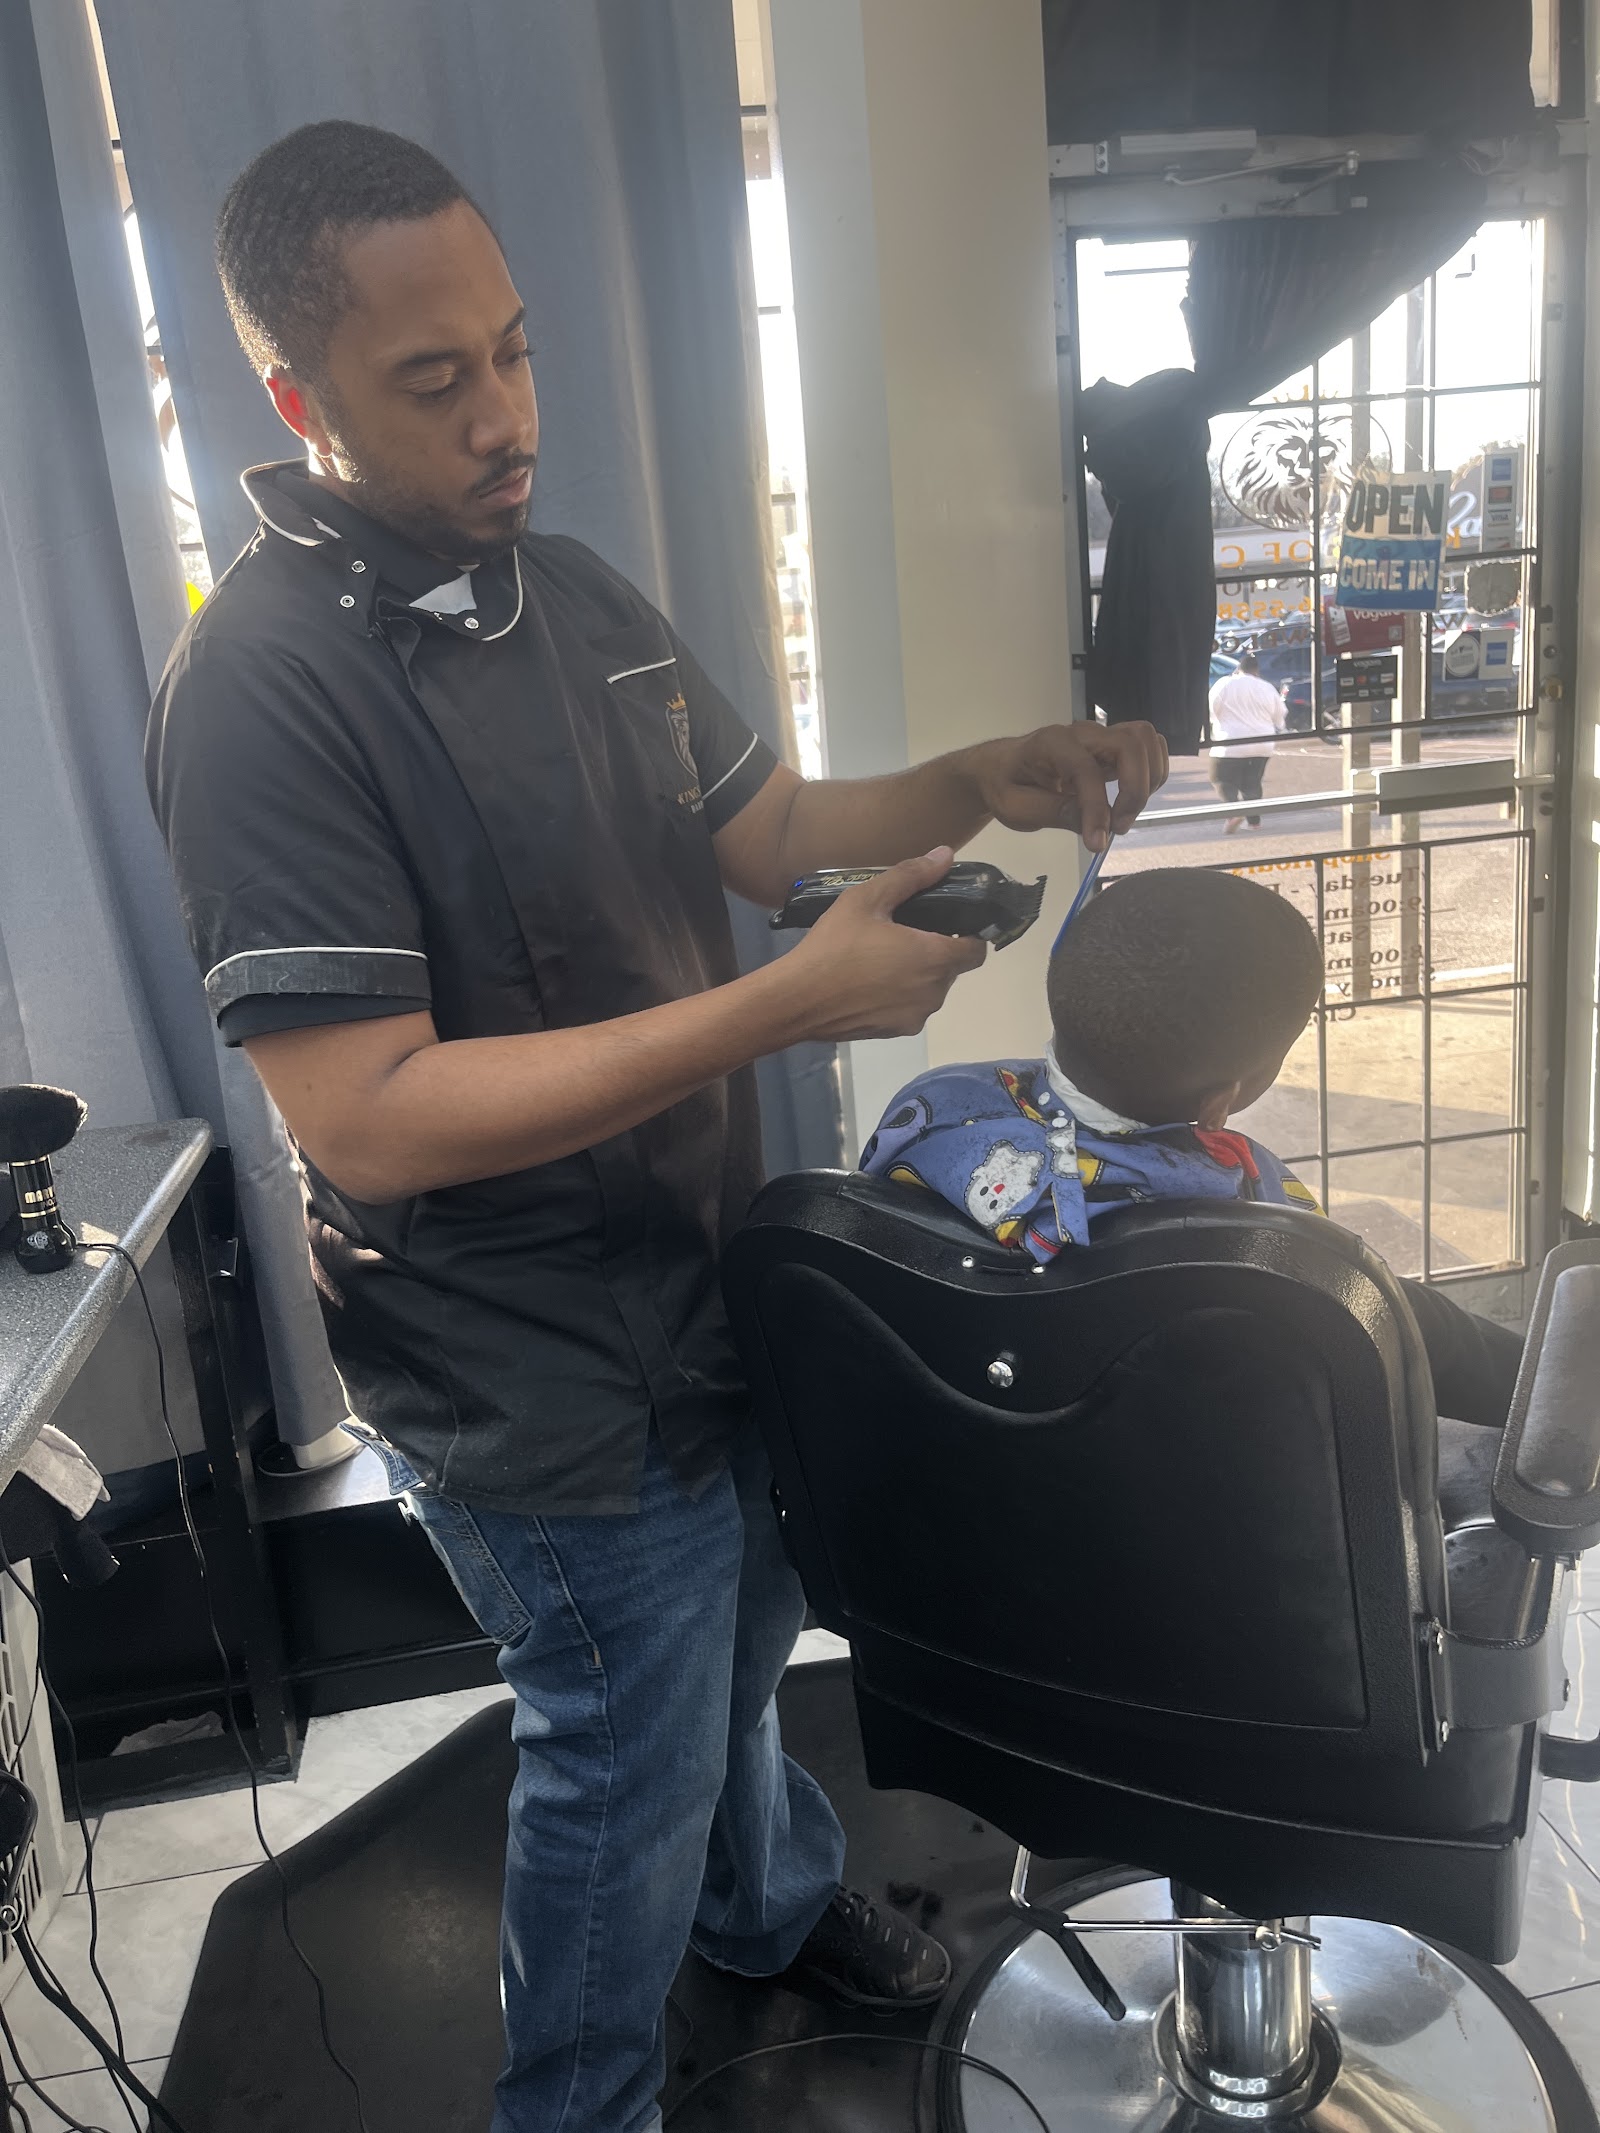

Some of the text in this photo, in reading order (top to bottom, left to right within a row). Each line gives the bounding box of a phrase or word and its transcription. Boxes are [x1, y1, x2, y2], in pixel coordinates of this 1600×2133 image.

[1345, 480, 1444, 534] OPEN
[1341, 555, 1404, 590] COME
[1408, 559, 1436, 591] IN
